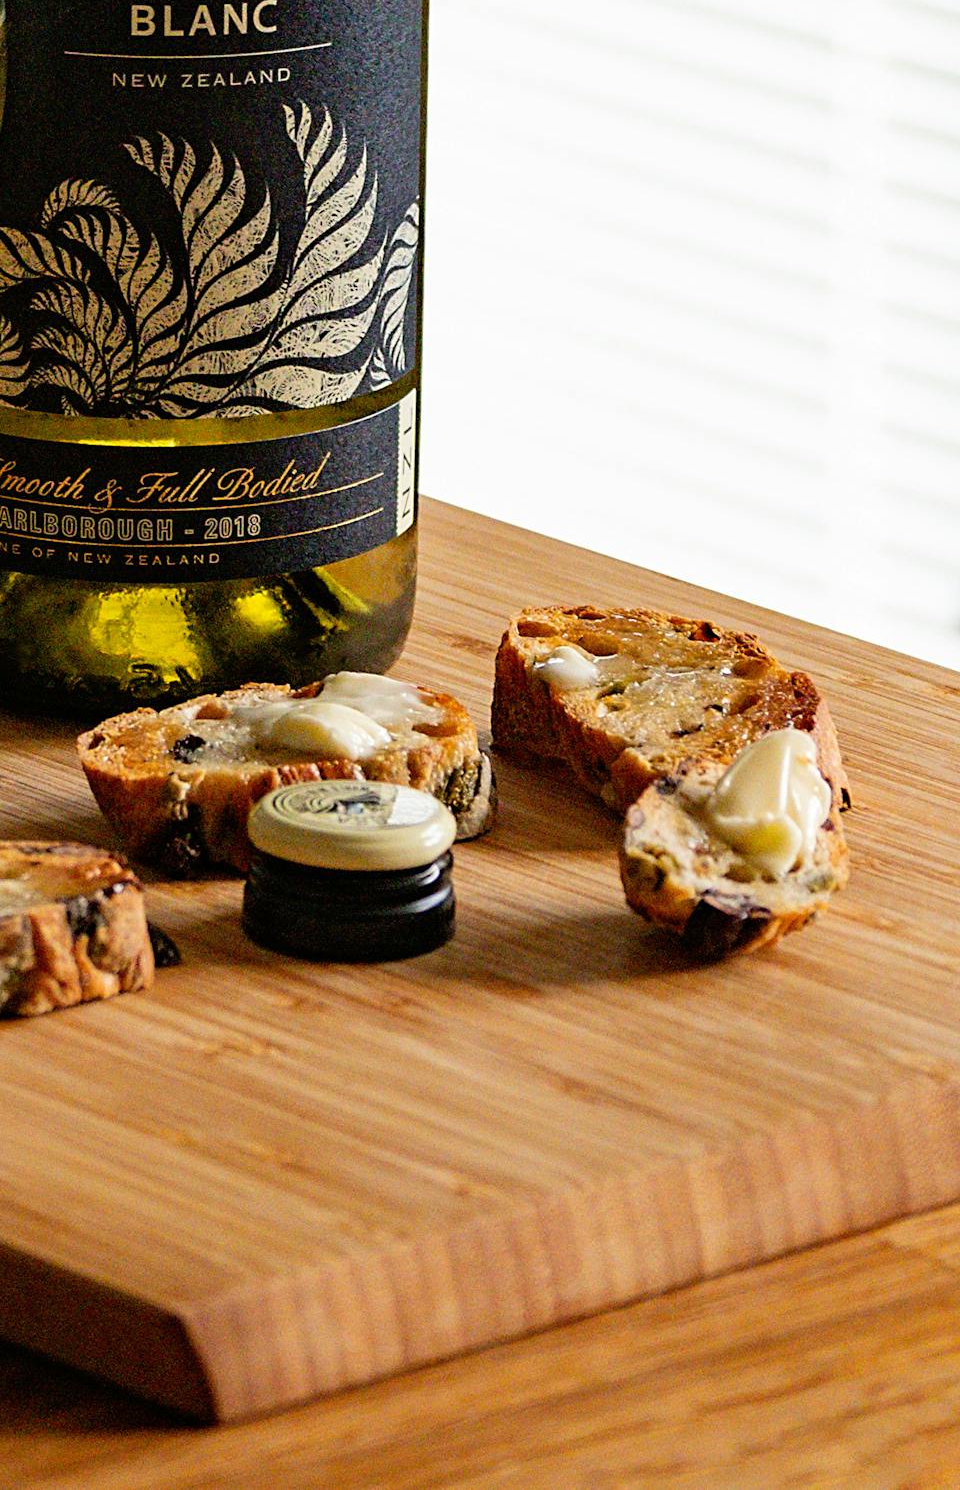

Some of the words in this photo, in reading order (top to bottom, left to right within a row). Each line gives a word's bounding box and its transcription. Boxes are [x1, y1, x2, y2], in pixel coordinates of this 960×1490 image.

[130, 0, 278, 37] BLANC
[112, 72, 168, 88] NEW
[182, 67, 291, 88] ZEALAND
[89, 478, 123, 514] &
[125, 467, 216, 503] Full
[212, 450, 332, 501] Bodied
[203, 513, 262, 540] 2018
[31, 546, 56, 559] OF
[67, 551, 112, 565] NEW
[125, 552, 221, 566] ZEALAND
